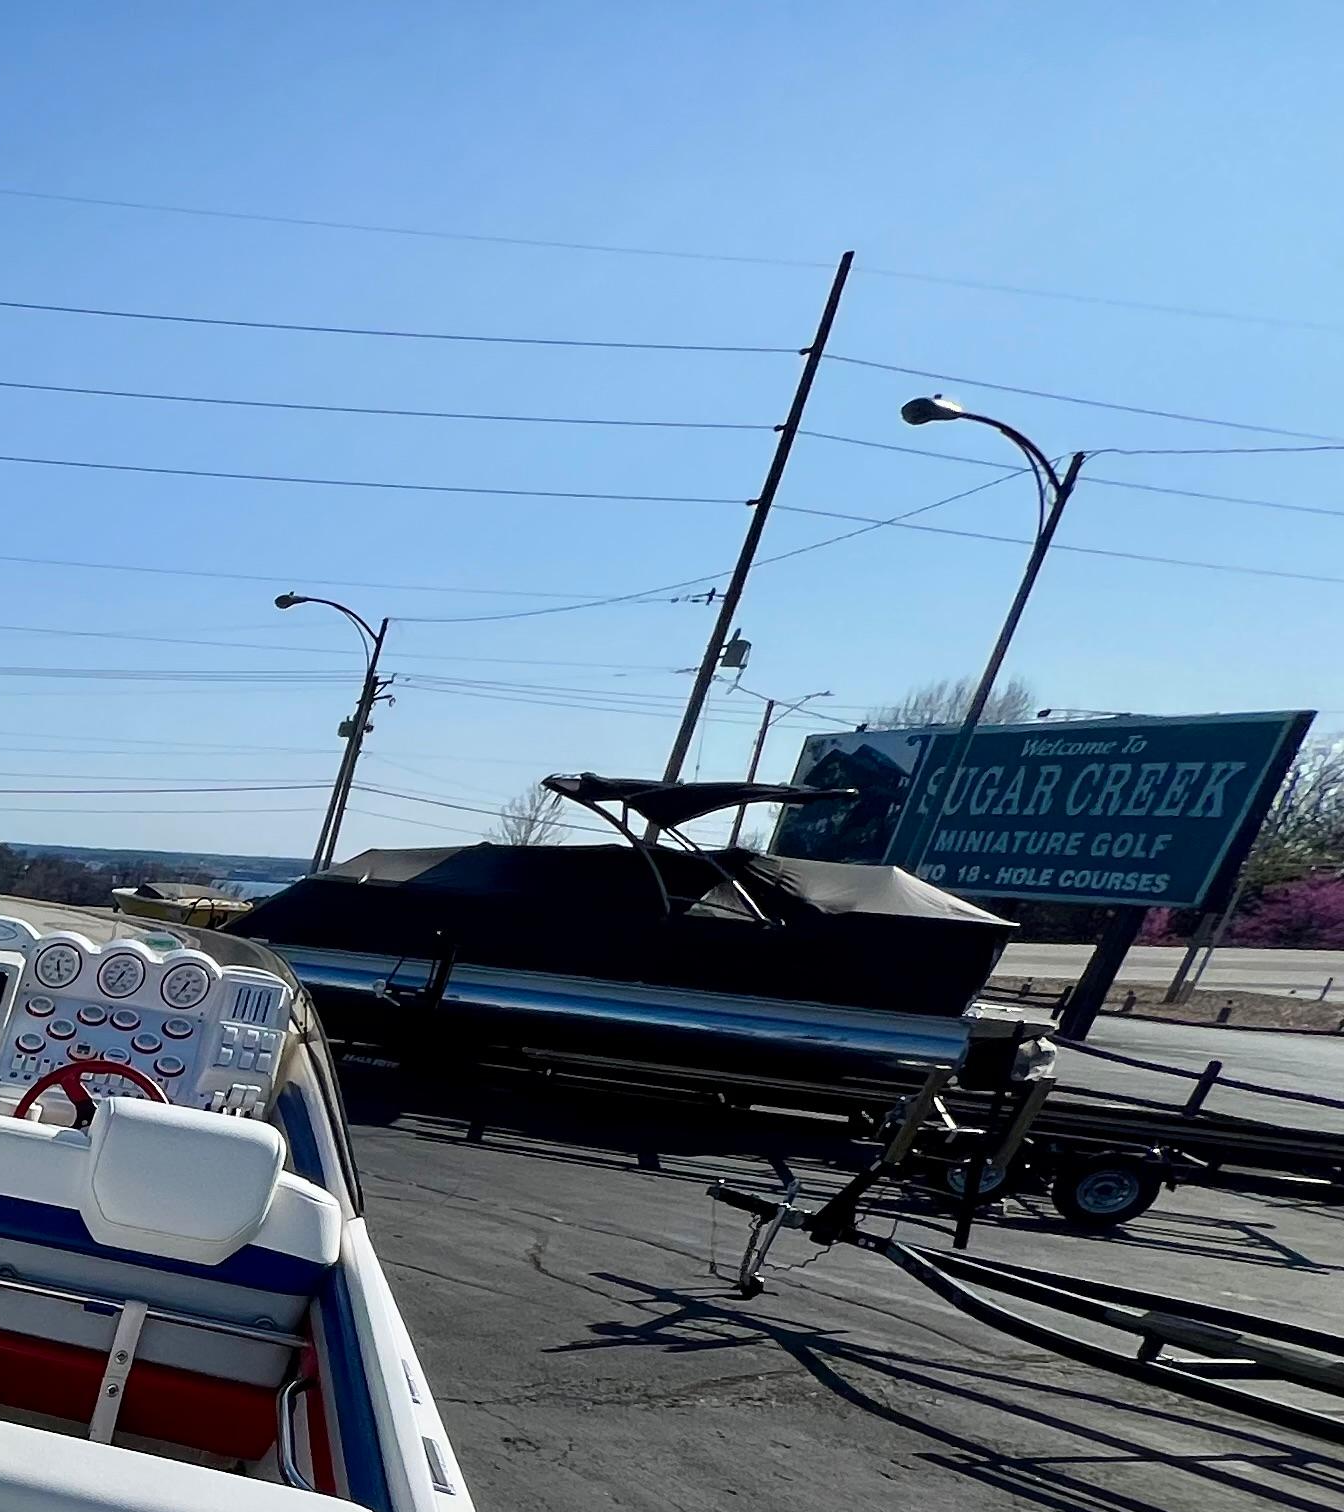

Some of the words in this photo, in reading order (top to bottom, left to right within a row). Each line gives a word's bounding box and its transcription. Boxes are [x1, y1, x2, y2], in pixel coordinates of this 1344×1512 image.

[1021, 738, 1117, 757] Welcome
[1121, 735, 1148, 754] To
[1065, 761, 1247, 818] CREEK
[933, 831, 1085, 857] MINIATURE
[1091, 834, 1173, 859] GOLF
[957, 865, 982, 883] 18
[994, 866, 1055, 886] HOLE
[1057, 870, 1171, 893] COURSES
